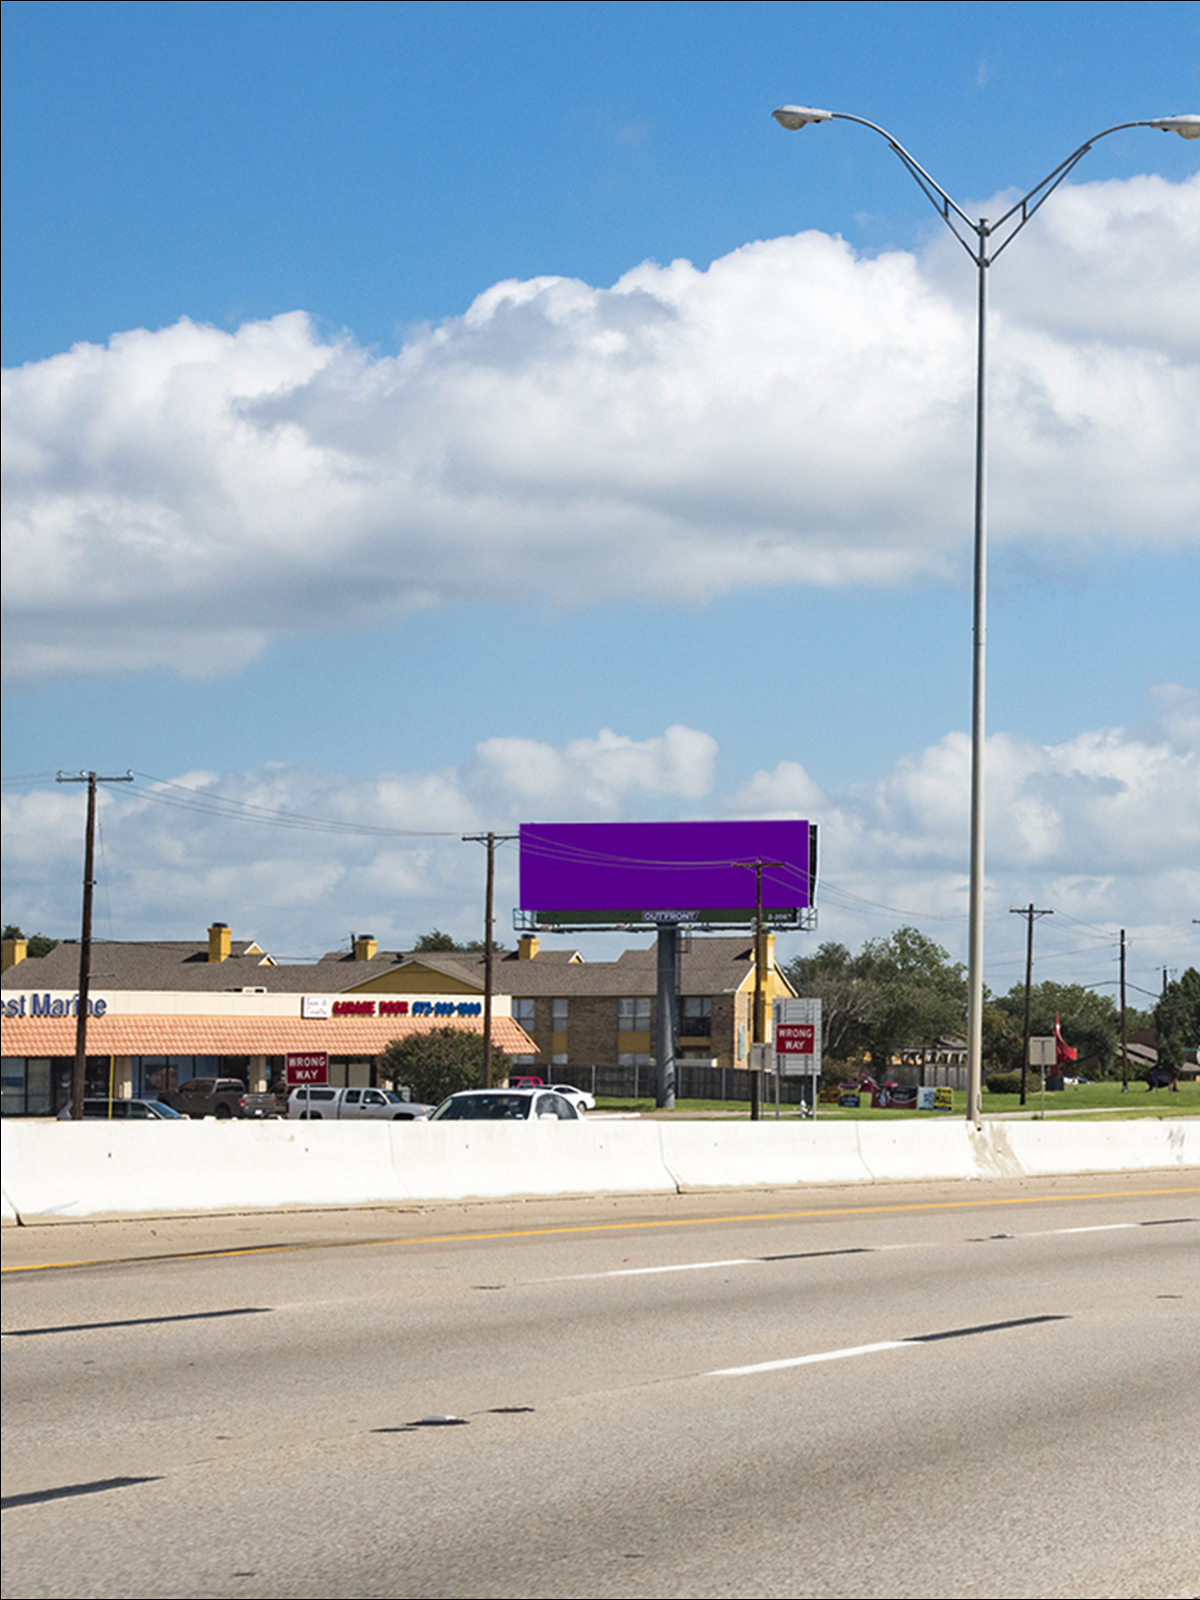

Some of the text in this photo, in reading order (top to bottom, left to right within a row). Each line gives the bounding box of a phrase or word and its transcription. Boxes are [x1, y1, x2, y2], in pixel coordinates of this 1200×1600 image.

[643, 911, 699, 920] OUTFRONT
[333, 1001, 377, 1014] GARAGE
[379, 1001, 409, 1014] DOOR
[778, 1029, 812, 1038] WRONG
[785, 1040, 805, 1050] WAY
[289, 1056, 326, 1067] WRONG
[295, 1070, 318, 1080] WAY
